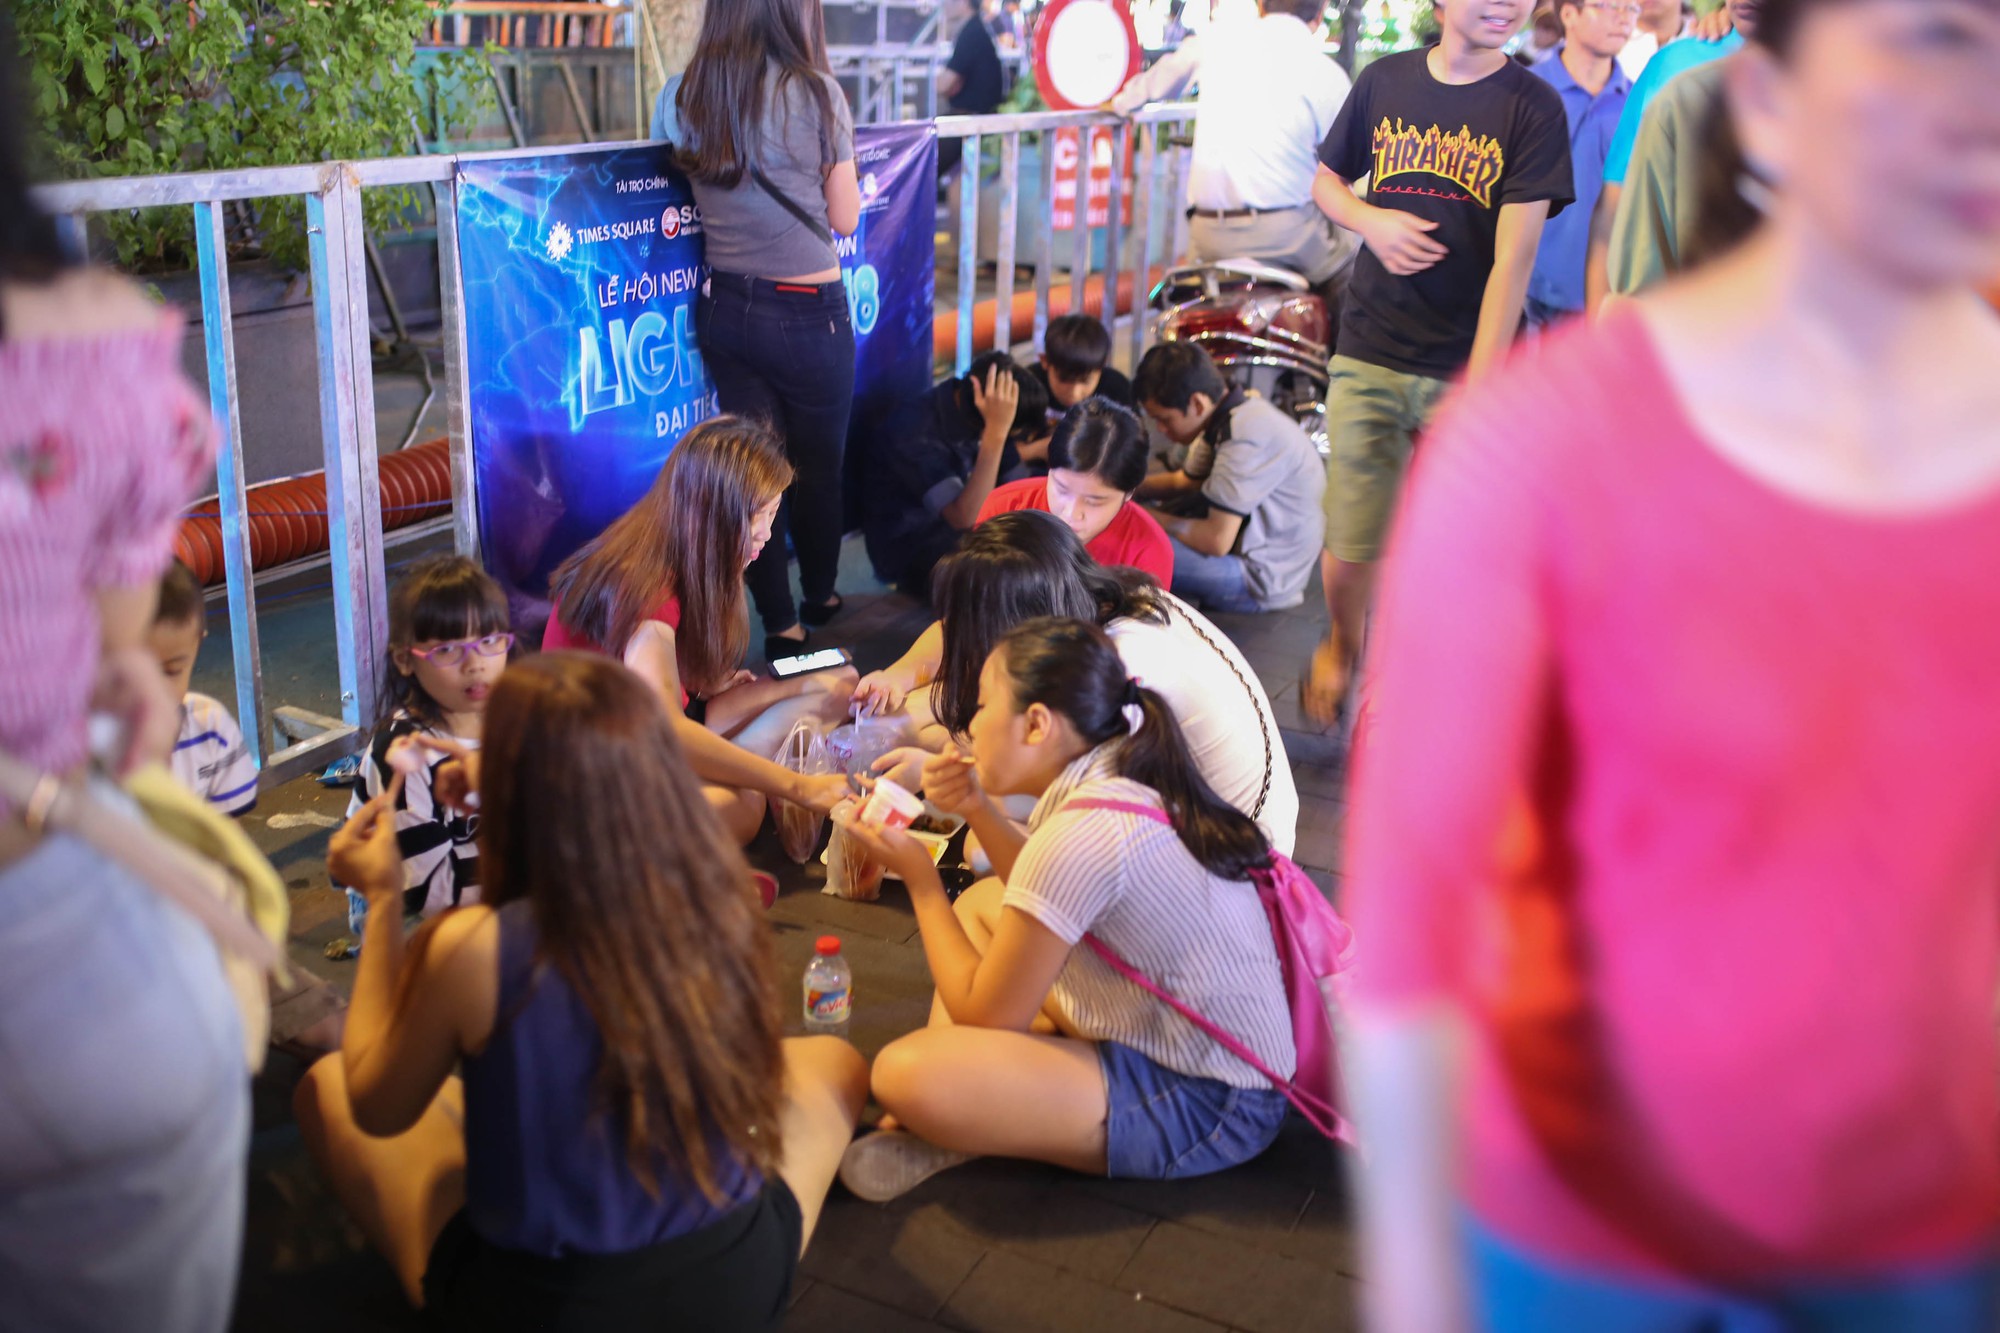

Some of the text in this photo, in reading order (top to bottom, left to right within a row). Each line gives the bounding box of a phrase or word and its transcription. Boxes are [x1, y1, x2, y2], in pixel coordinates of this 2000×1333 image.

[1372, 116, 1504, 209] THRASHER
[616, 179, 628, 194] TÀI
[1378, 185, 1472, 201] MAGAZINE
[577, 224, 611, 245] TIMES
[611, 218, 656, 240] SQUARE
[598, 265, 698, 308] LỄ HỘI NEW
[655, 403, 688, 439] ĐẠI
